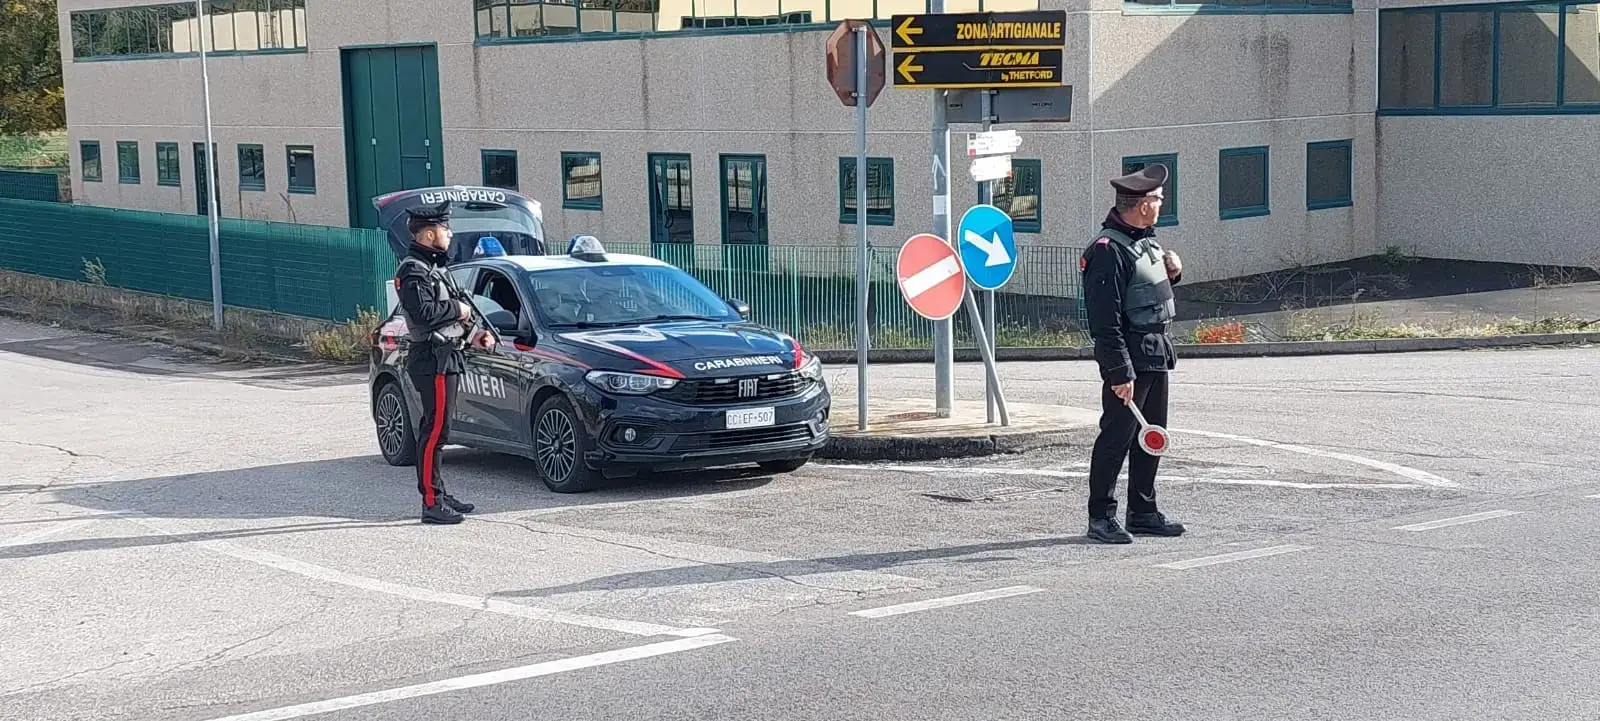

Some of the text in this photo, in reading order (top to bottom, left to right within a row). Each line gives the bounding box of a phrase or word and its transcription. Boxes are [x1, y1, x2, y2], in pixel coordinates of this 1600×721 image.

[956, 22, 1061, 40] ZONA ARTIGIANALE
[979, 52, 1040, 66] TECMA
[1001, 70, 1053, 82] by THETFORD
[420, 189, 506, 204] CARABINIERI
[694, 355, 783, 371] CARABINIERI
[458, 371, 506, 400] INIERI
[738, 378, 759, 398] FIAT
